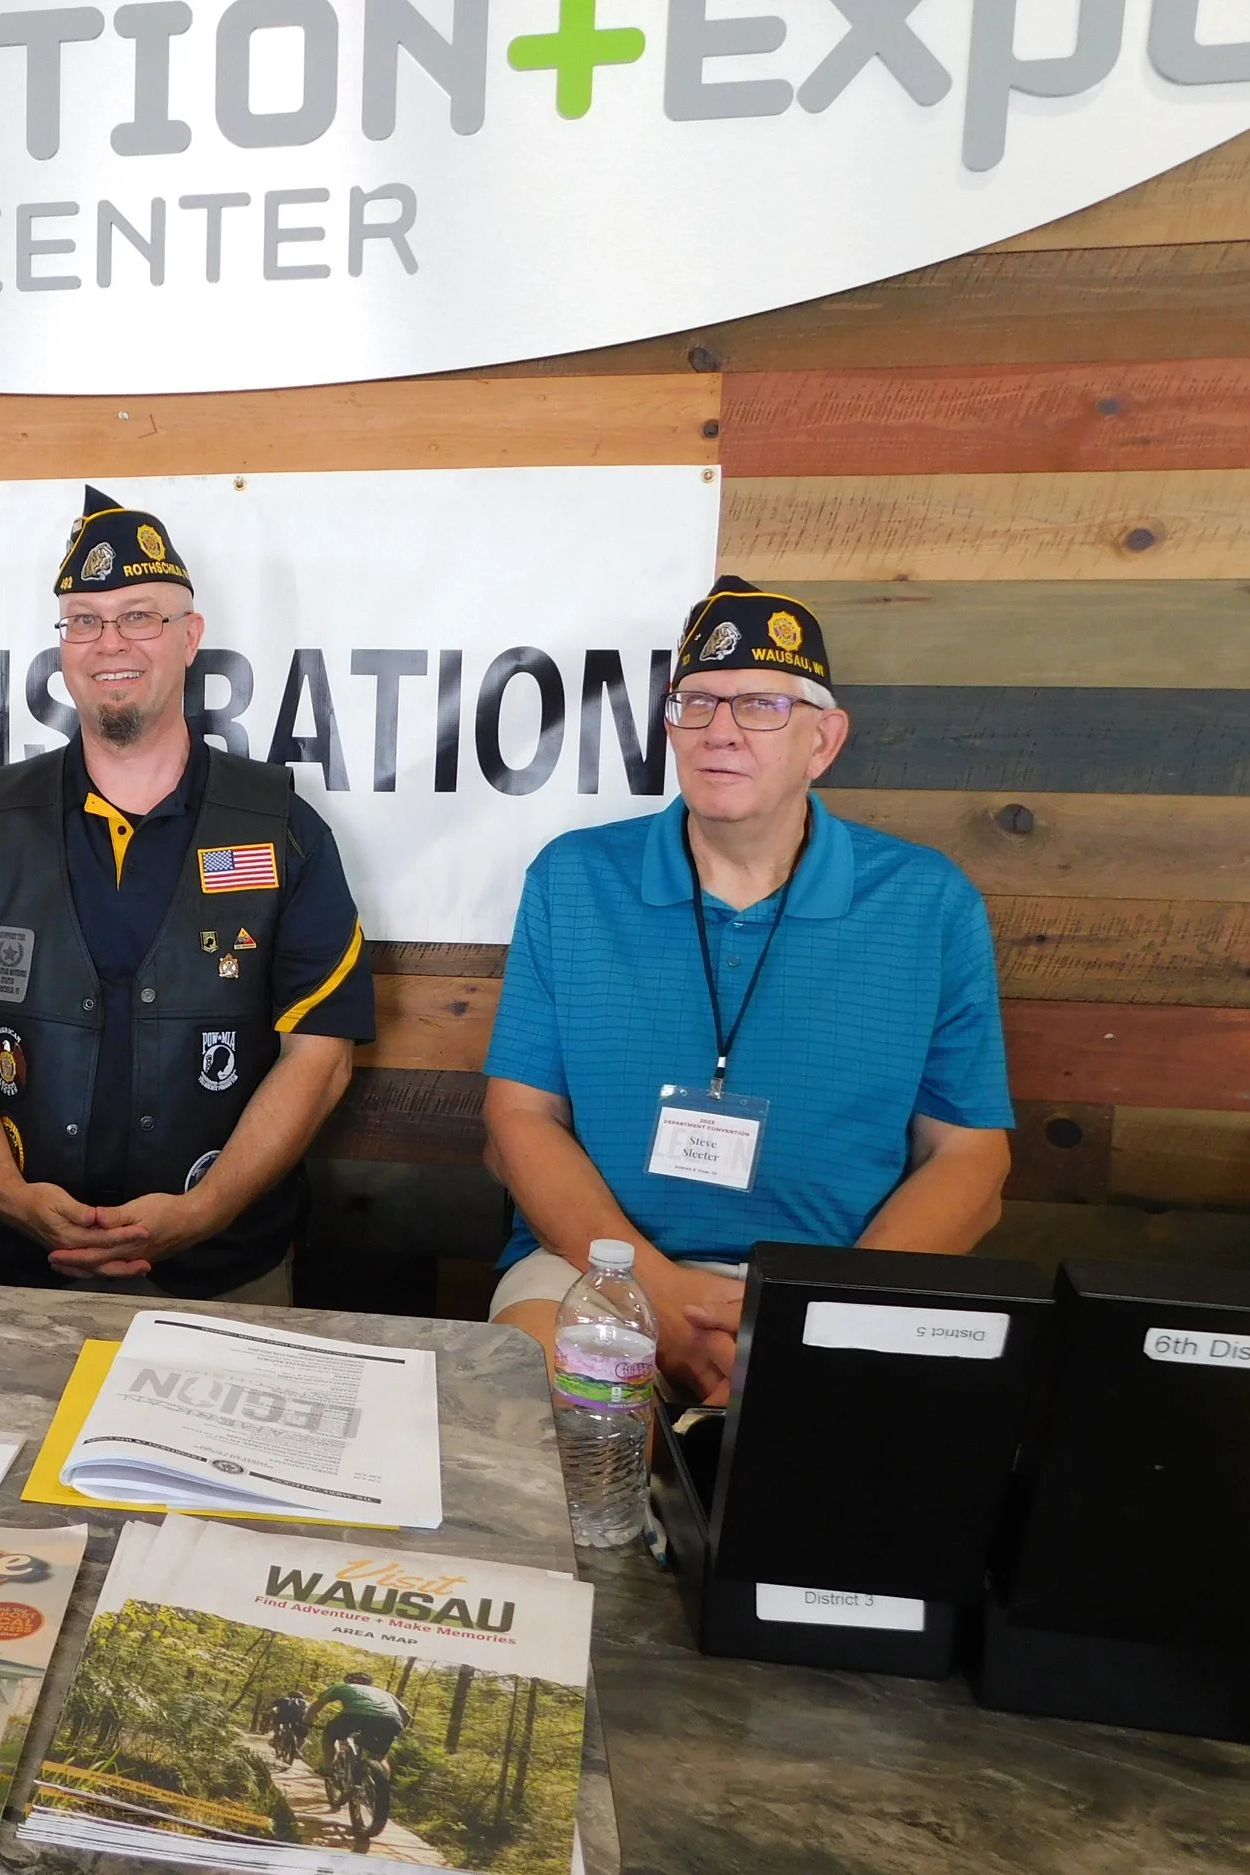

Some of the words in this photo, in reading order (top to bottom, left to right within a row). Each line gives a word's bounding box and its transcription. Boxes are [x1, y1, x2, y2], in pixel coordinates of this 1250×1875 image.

[751, 648, 813, 673] WAUSAU,
[813, 660, 825, 677] WI
[663, 1119, 706, 1129] DEPARTMENT
[707, 1125, 750, 1137] CONVENTION
[689, 1136, 718, 1148] Steve
[682, 1148, 720, 1162] Sleeter
[917, 1326, 927, 1337] 5
[931, 1327, 985, 1342] District
[1155, 1334, 1198, 1356] 6th
[335, 1558, 468, 1595] Visit
[265, 1564, 517, 1633] WAUSAU
[804, 1591, 859, 1606] District
[864, 1594, 875, 1607] 3
[254, 1595, 288, 1609] Find
[290, 1601, 371, 1623] Adventure
[388, 1618, 432, 1634] Make
[436, 1623, 518, 1645] Memories
[331, 1626, 375, 1639] AREA
[380, 1633, 418, 1645] MAP
[89, 1773, 118, 1784] PHOTO
